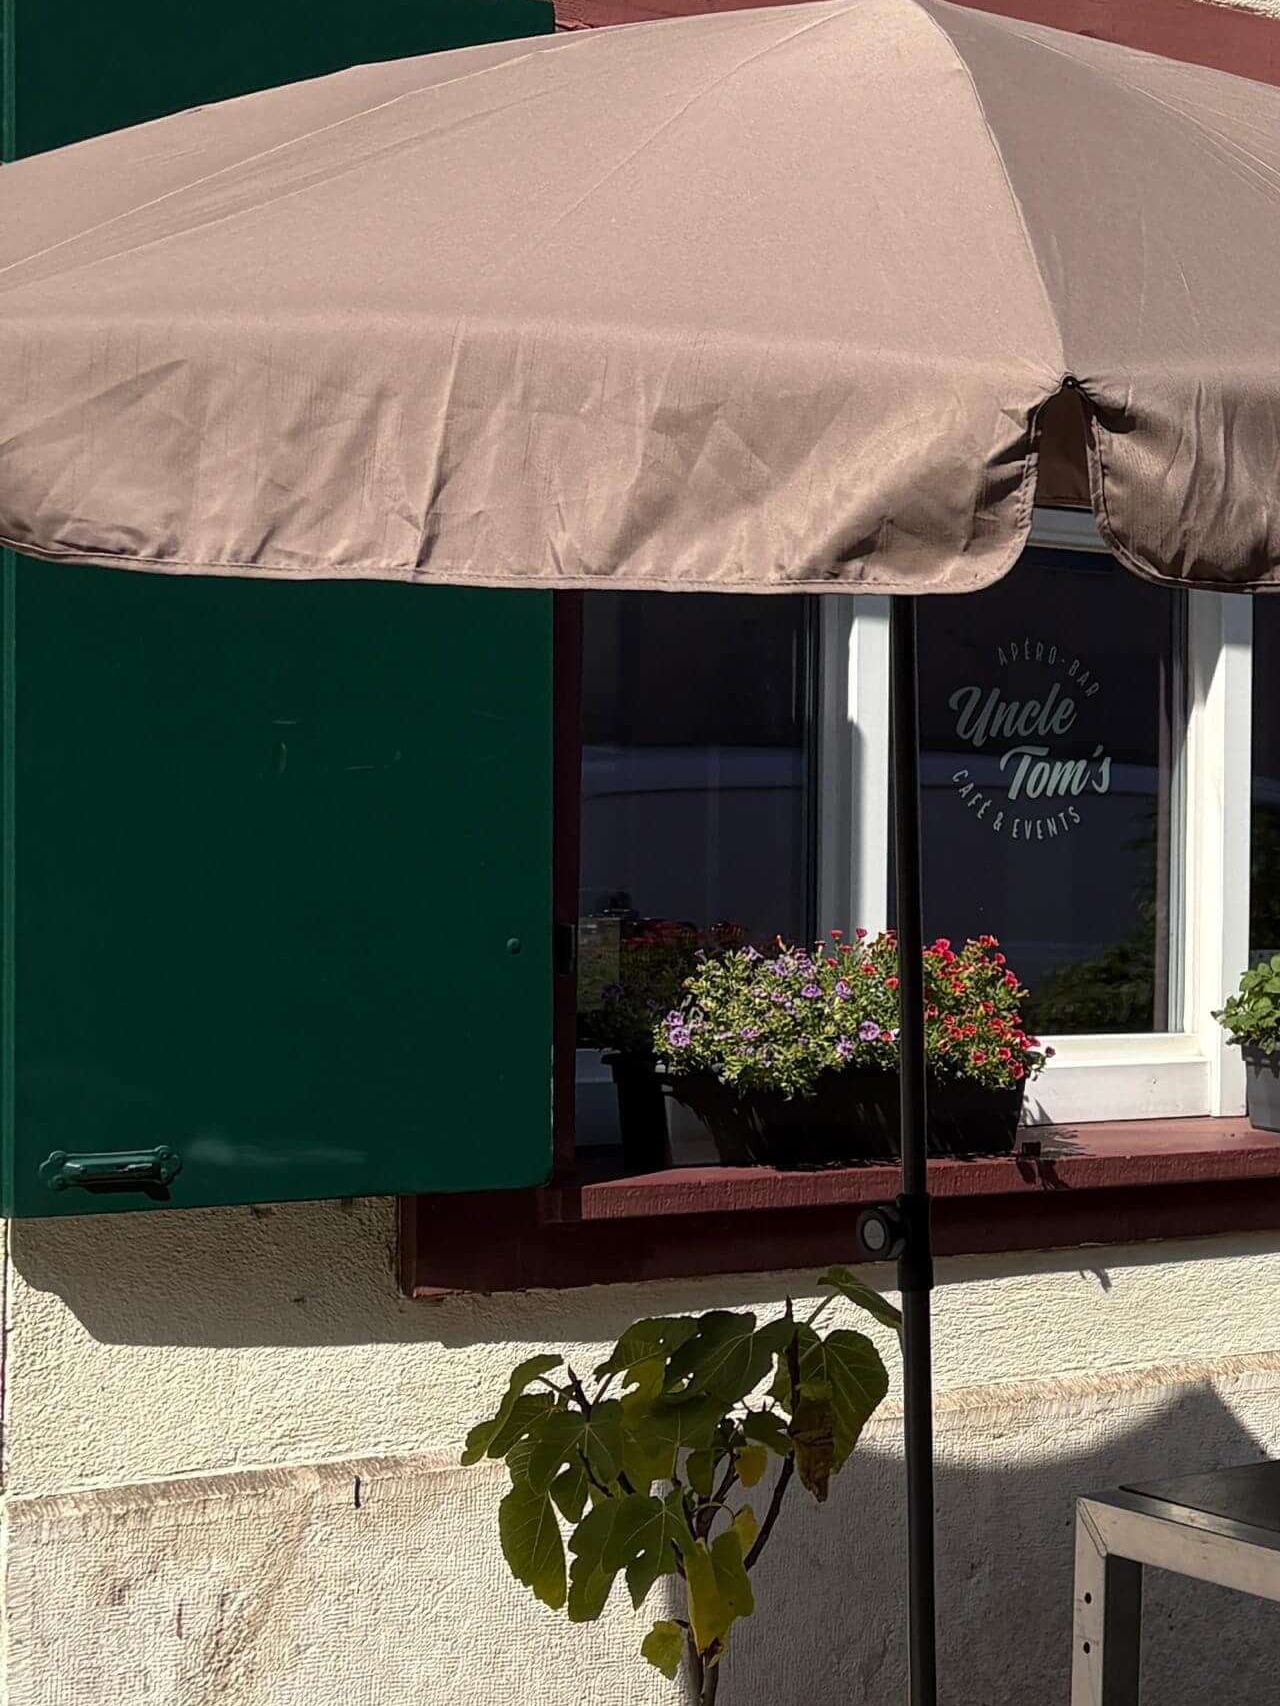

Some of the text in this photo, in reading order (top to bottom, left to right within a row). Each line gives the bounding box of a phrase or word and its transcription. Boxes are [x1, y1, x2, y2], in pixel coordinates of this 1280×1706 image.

[949, 683, 1077, 747] Uncle
[1000, 745, 1112, 800] Tom's
[993, 811, 1003, 831] &
[1012, 806, 1081, 840] EVENTS
